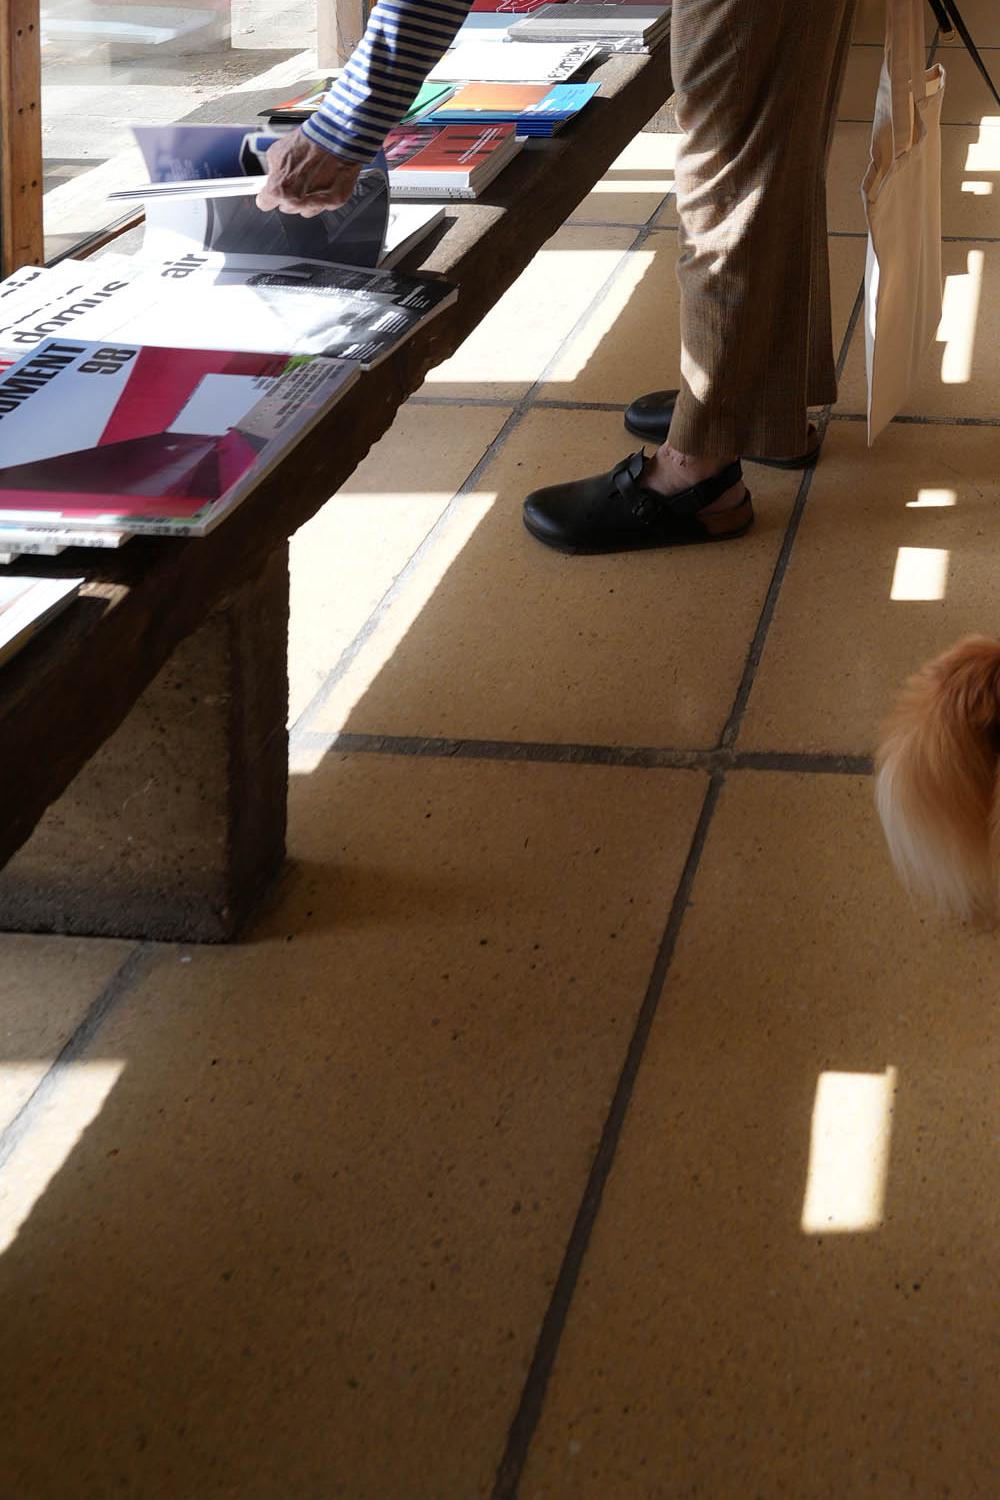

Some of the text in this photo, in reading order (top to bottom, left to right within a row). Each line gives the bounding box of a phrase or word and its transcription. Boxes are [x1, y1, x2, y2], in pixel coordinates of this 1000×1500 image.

[161, 253, 209, 279] air
[12, 280, 130, 344] domus
[77, 347, 138, 375] 98
